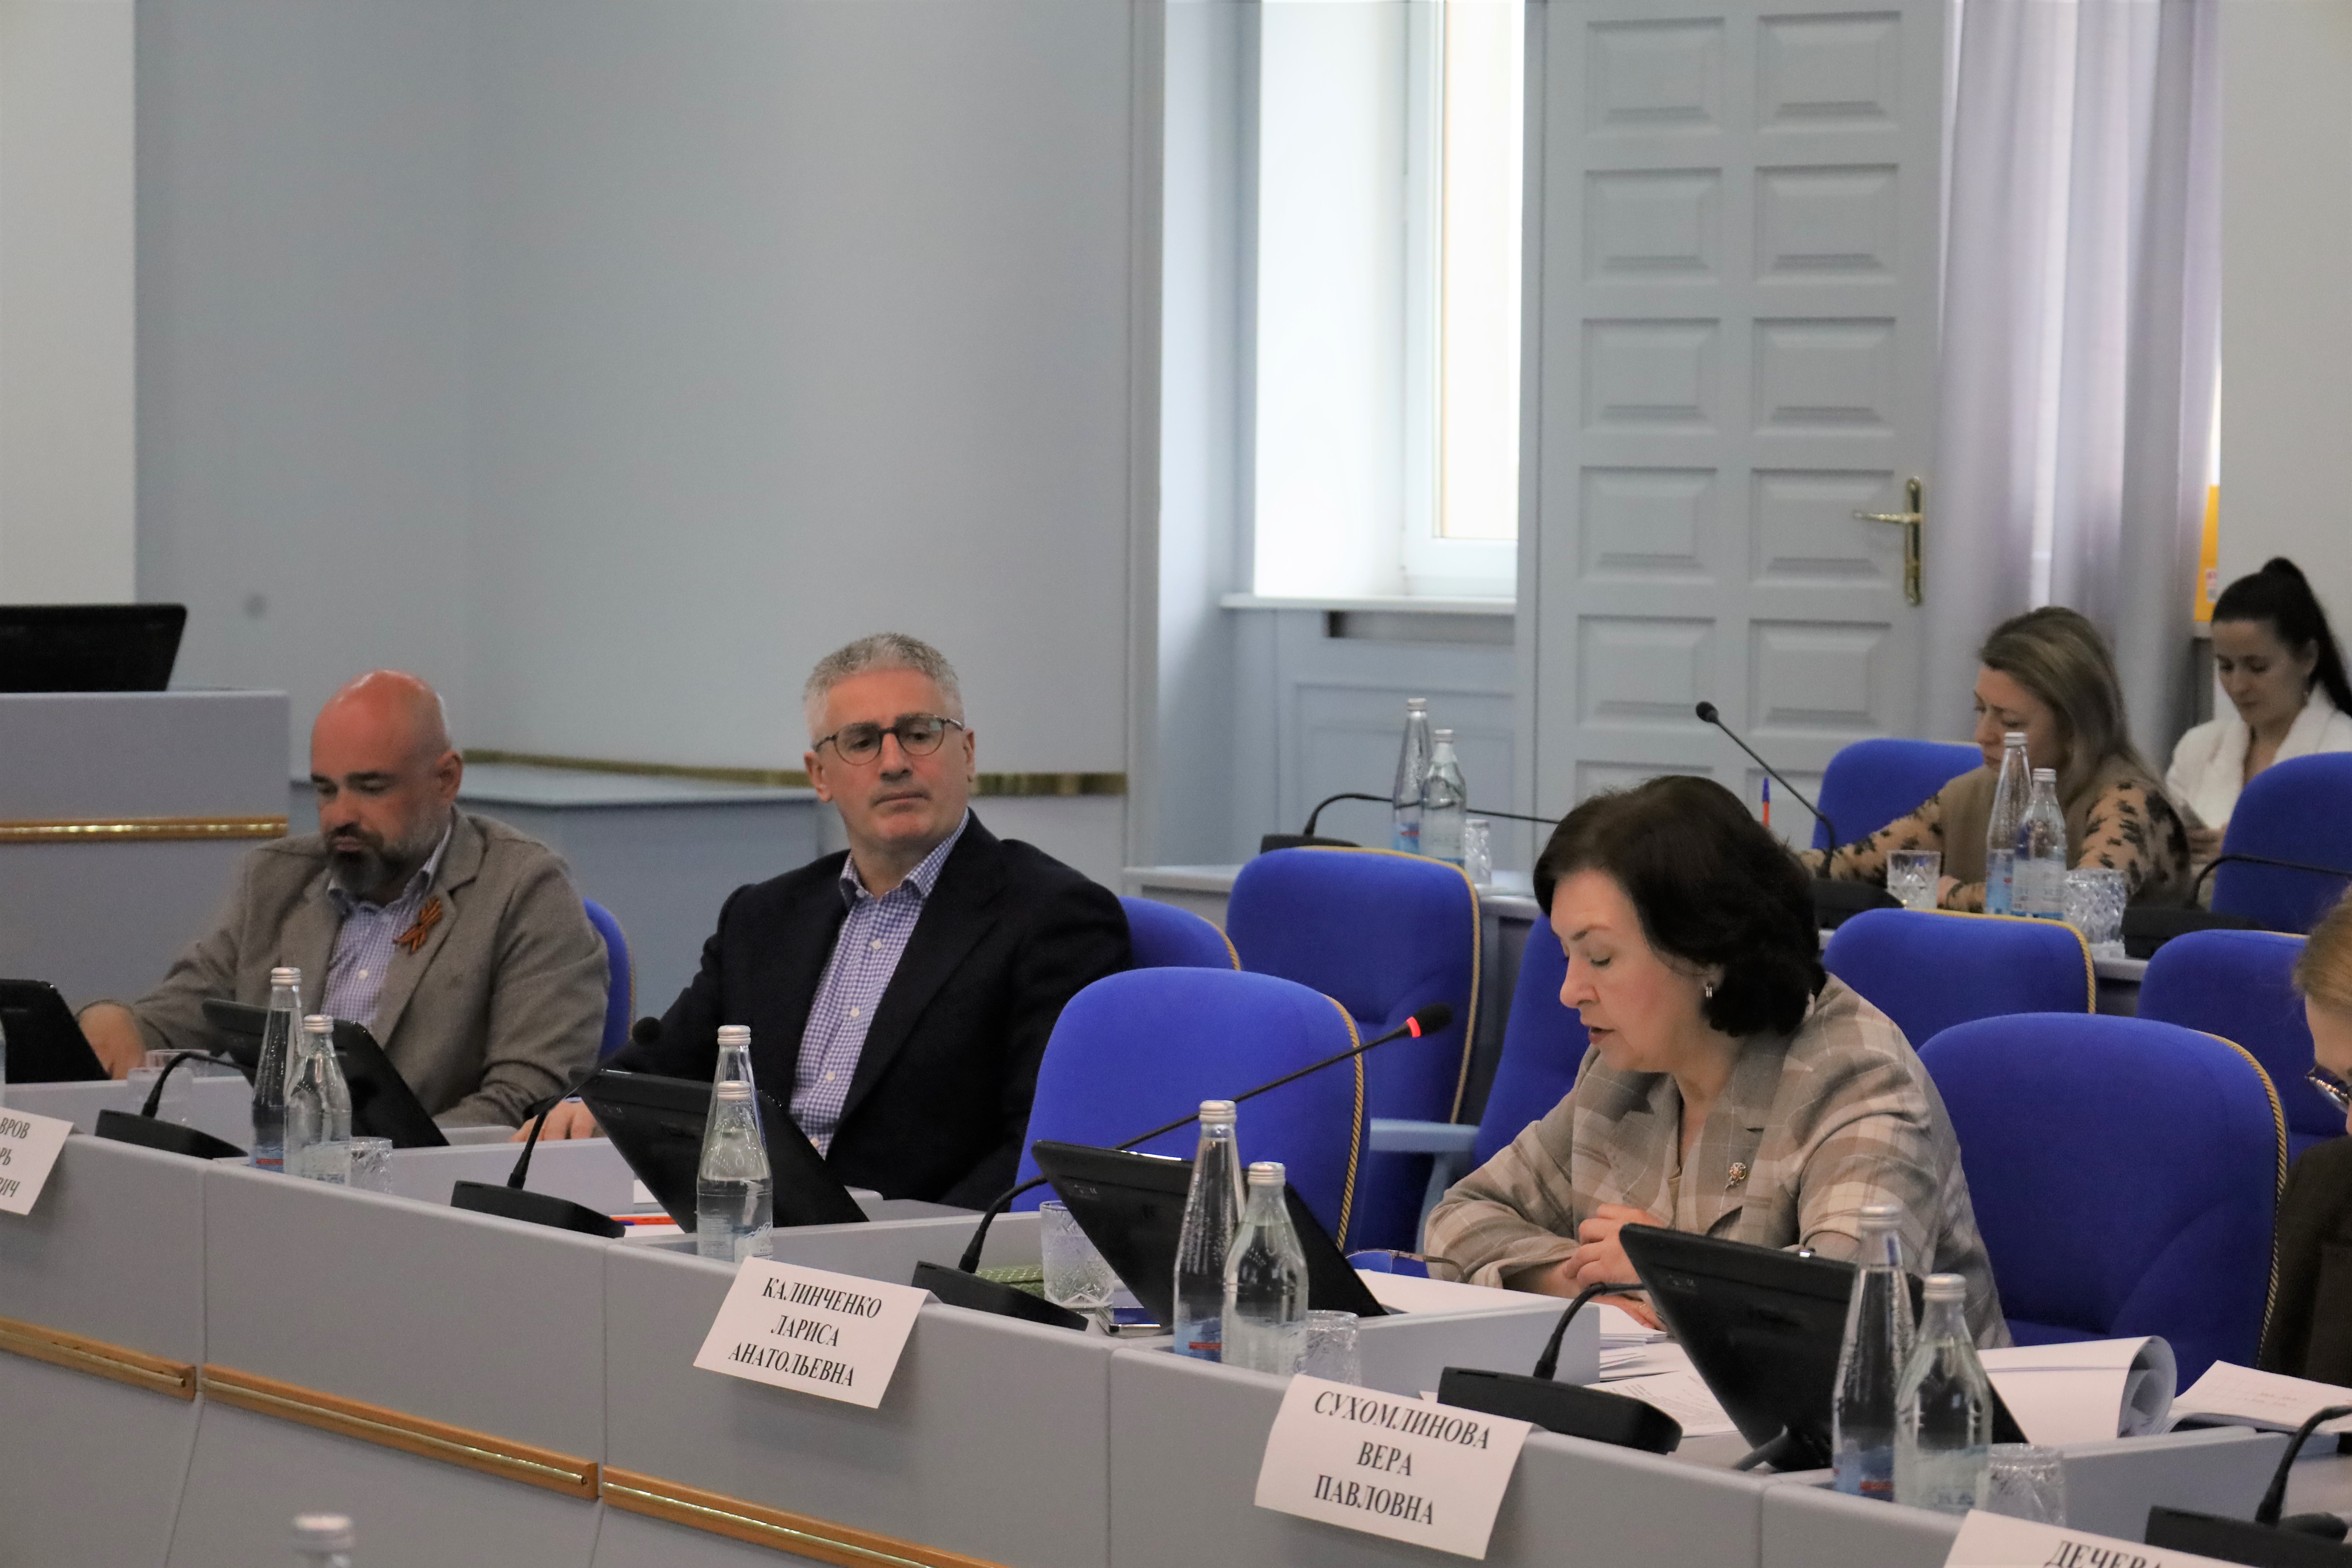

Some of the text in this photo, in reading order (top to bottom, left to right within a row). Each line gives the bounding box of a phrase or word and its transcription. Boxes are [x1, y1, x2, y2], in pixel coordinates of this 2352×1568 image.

[761, 1277, 882, 1318] КАЛИНЧЕНКО
[770, 1314, 839, 1347] ЛАРИСА
[728, 1342, 854, 1387] АНАТОЛЬЕВНА
[1314, 1391, 1490, 1449] СУХОМЛИНОВА
[1357, 1441, 1412, 1476] ВЕРА
[1314, 1474, 1433, 1525] ПАВЛОВНА
[2043, 1540, 2161, 1568] ДЕЧЕВ
